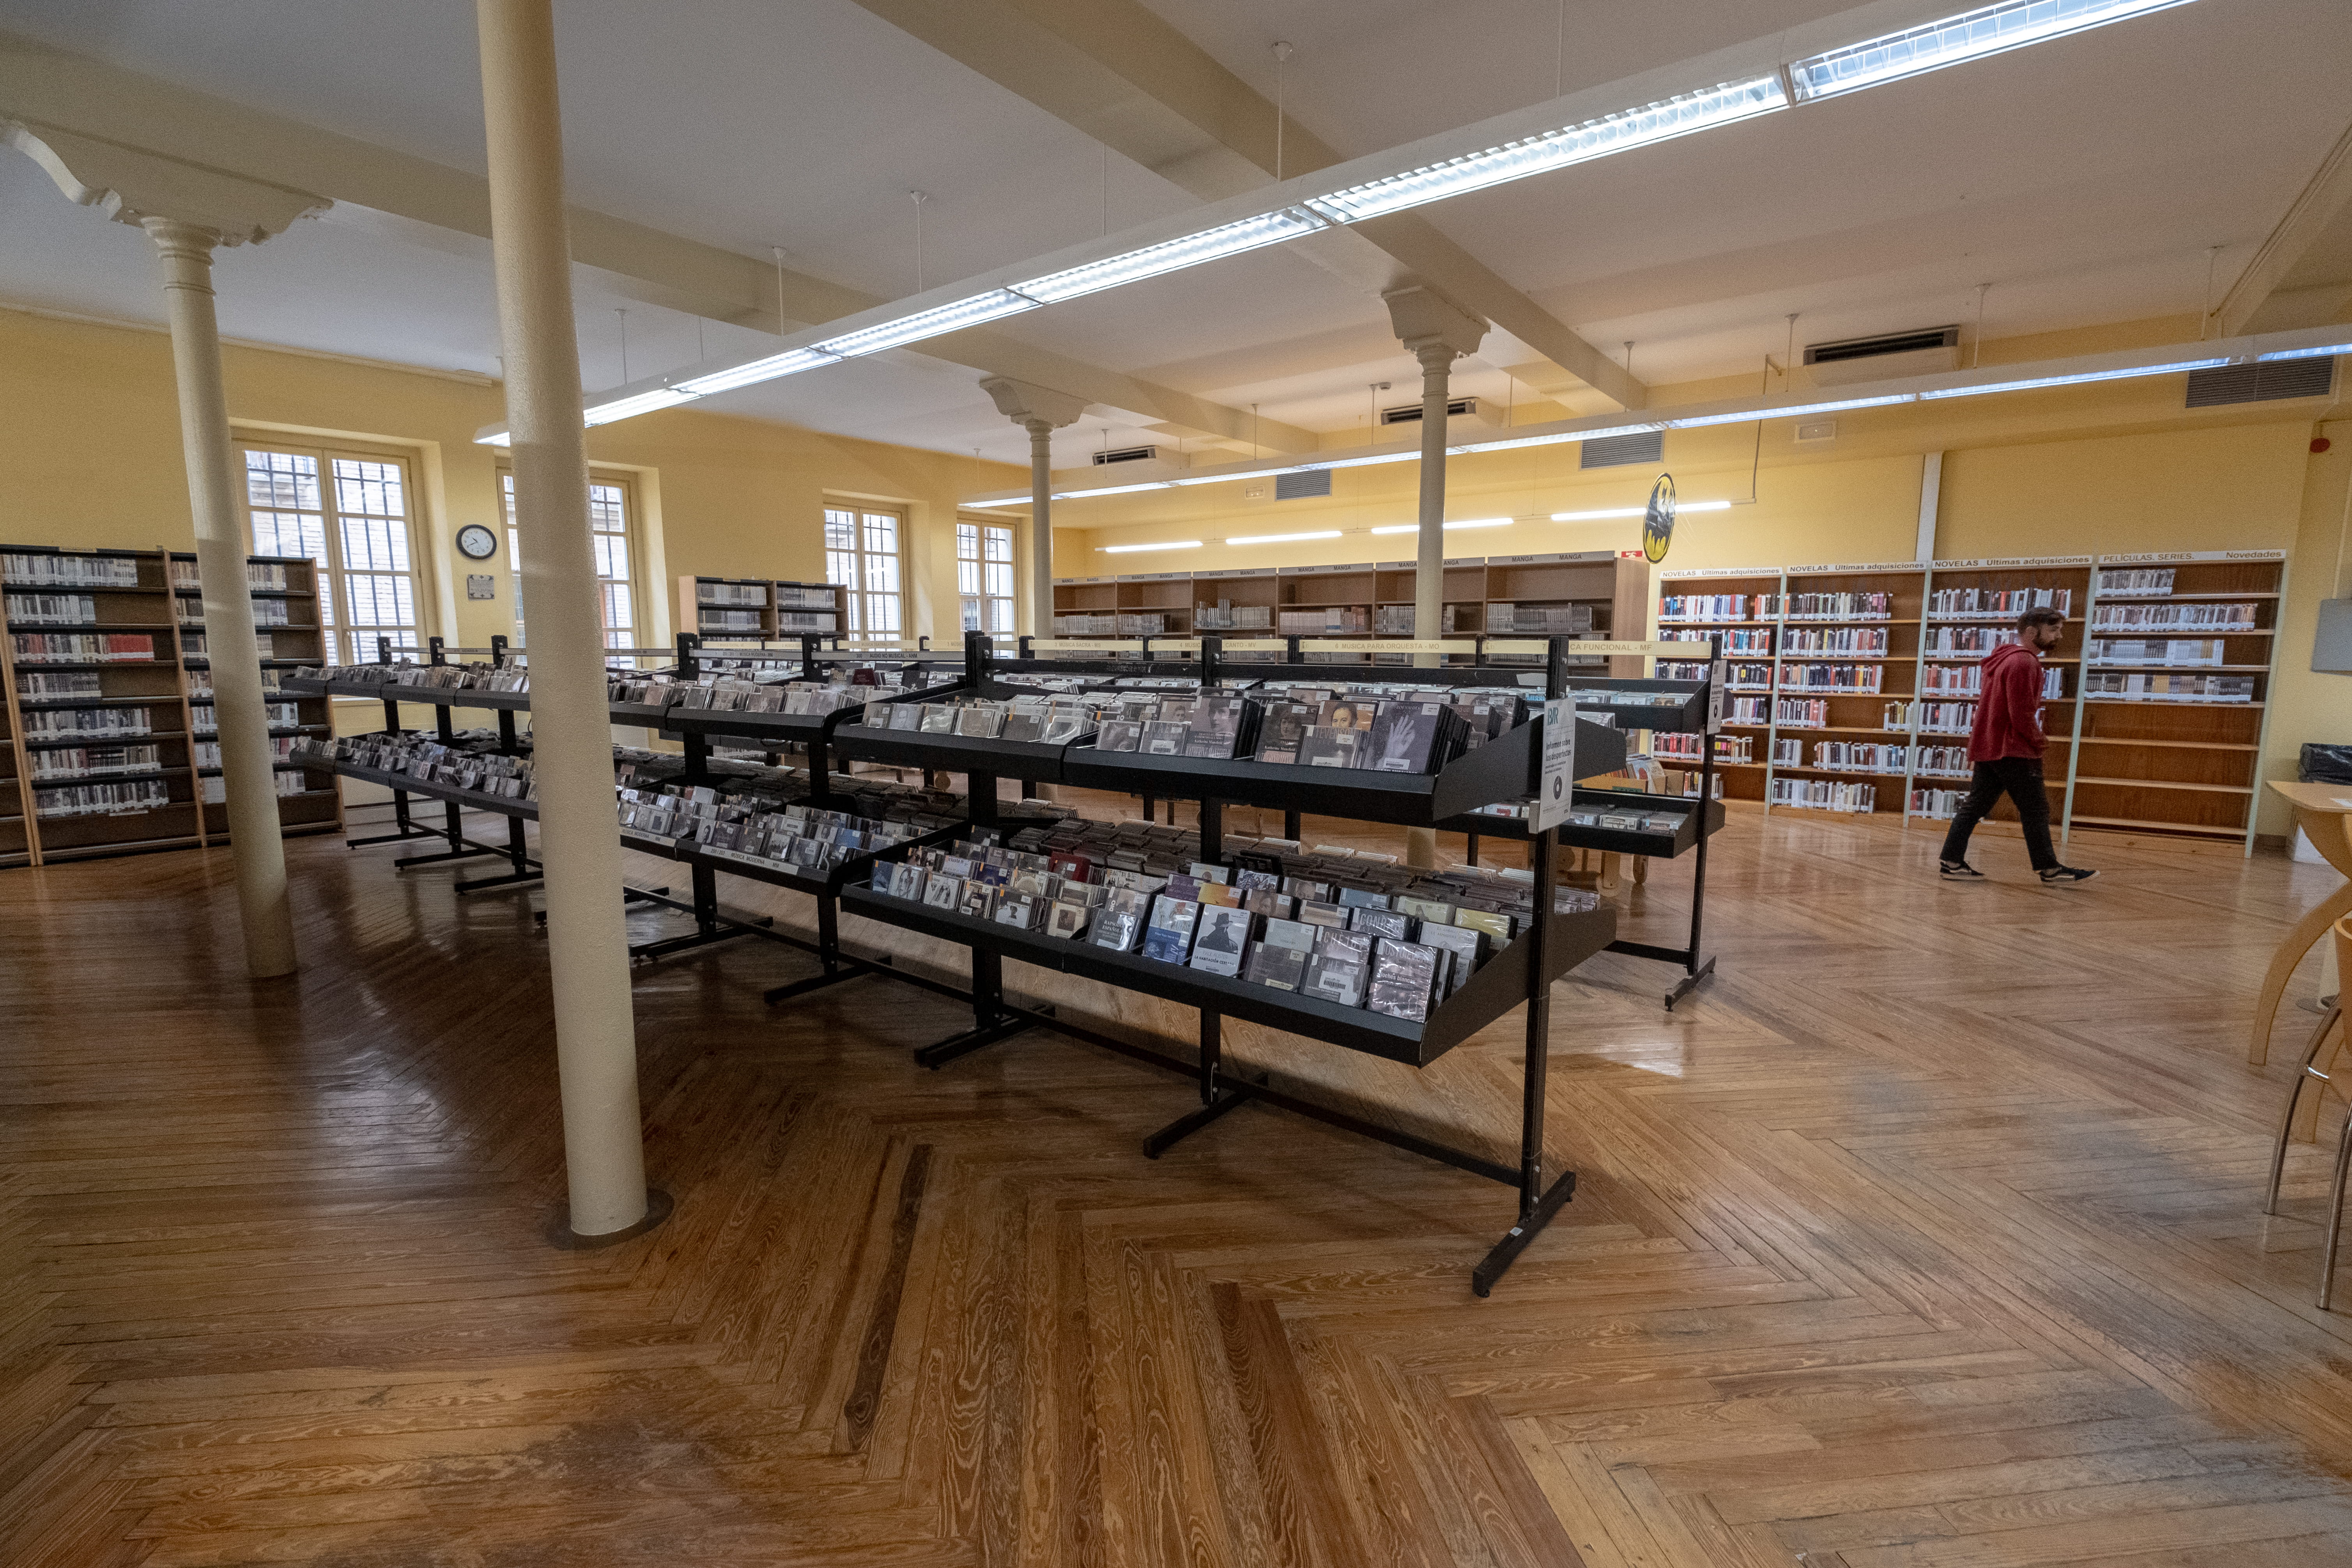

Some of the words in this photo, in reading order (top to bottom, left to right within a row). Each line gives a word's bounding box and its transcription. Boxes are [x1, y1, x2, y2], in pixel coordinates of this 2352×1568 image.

[2023, 557, 2089, 566] adquisiciones
[2104, 554, 2155, 562] PELÍCULAS.
[2226, 551, 2281, 559] Novedades
[1867, 563, 1924, 571] adquisiciones
[1546, 742, 1561, 750] Informen
[1562, 738, 1571, 747] sobre
[1551, 749, 1571, 761] desperfectos
[746, 856, 765, 865] MODERNA
